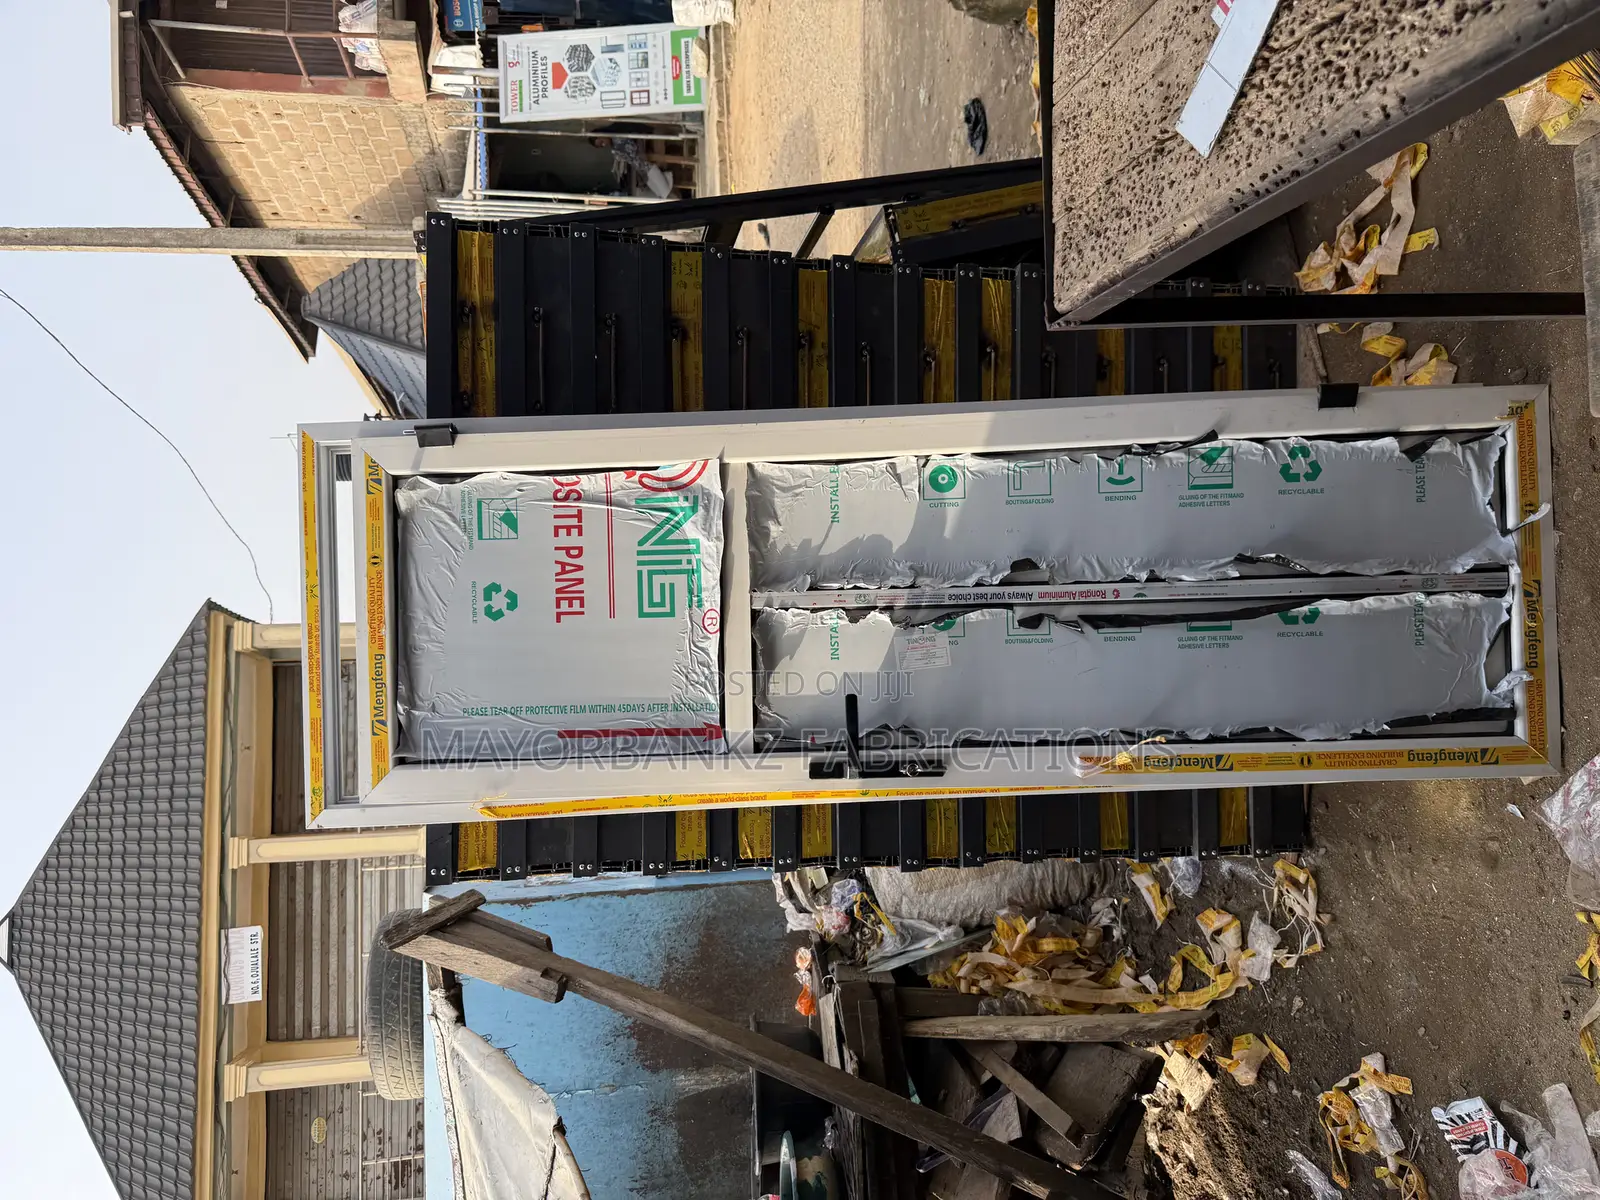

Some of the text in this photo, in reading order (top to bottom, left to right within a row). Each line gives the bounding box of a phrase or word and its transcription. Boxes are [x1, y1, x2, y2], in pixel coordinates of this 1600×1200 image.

[531, 50, 540, 105] ALUMINIUM
[540, 56, 549, 98] PROFILES
[1526, 419, 1536, 491] CRAFTING QUALITY
[1520, 450, 1528, 498] EXCELLENCE
[1416, 475, 1426, 502] PLEASE
[554, 546, 585, 623] PANEL
[990, 592, 1006, 600] your
[1008, 591, 1033, 601] Always
[1038, 591, 1077, 599] Aluminium
[1077, 590, 1106, 599] Rongtai
[1415, 620, 1424, 646] PLEASE
[1525, 599, 1541, 669] Mengfeng
[373, 653, 385, 718] Mengfeng
[1536, 678, 1544, 716] CRAFTING
[463, 707, 488, 716] PLEASE
[490, 706, 509, 716] TEAR
[510, 706, 524, 715] OFF
[526, 705, 568, 715] PROTECTIVE
[569, 705, 587, 714] FILM
[589, 704, 616, 713] WITHIN
[617, 703, 645, 713] 45DAYS
[647, 703, 668, 712] AFTER
[1144, 755, 1215, 769] Mengfeng
[1316, 752, 1365, 761] EXCELLENCE
[1324, 758, 1398, 768] CRAFTING QUALITY
[1407, 748, 1479, 764] Mengfeng
